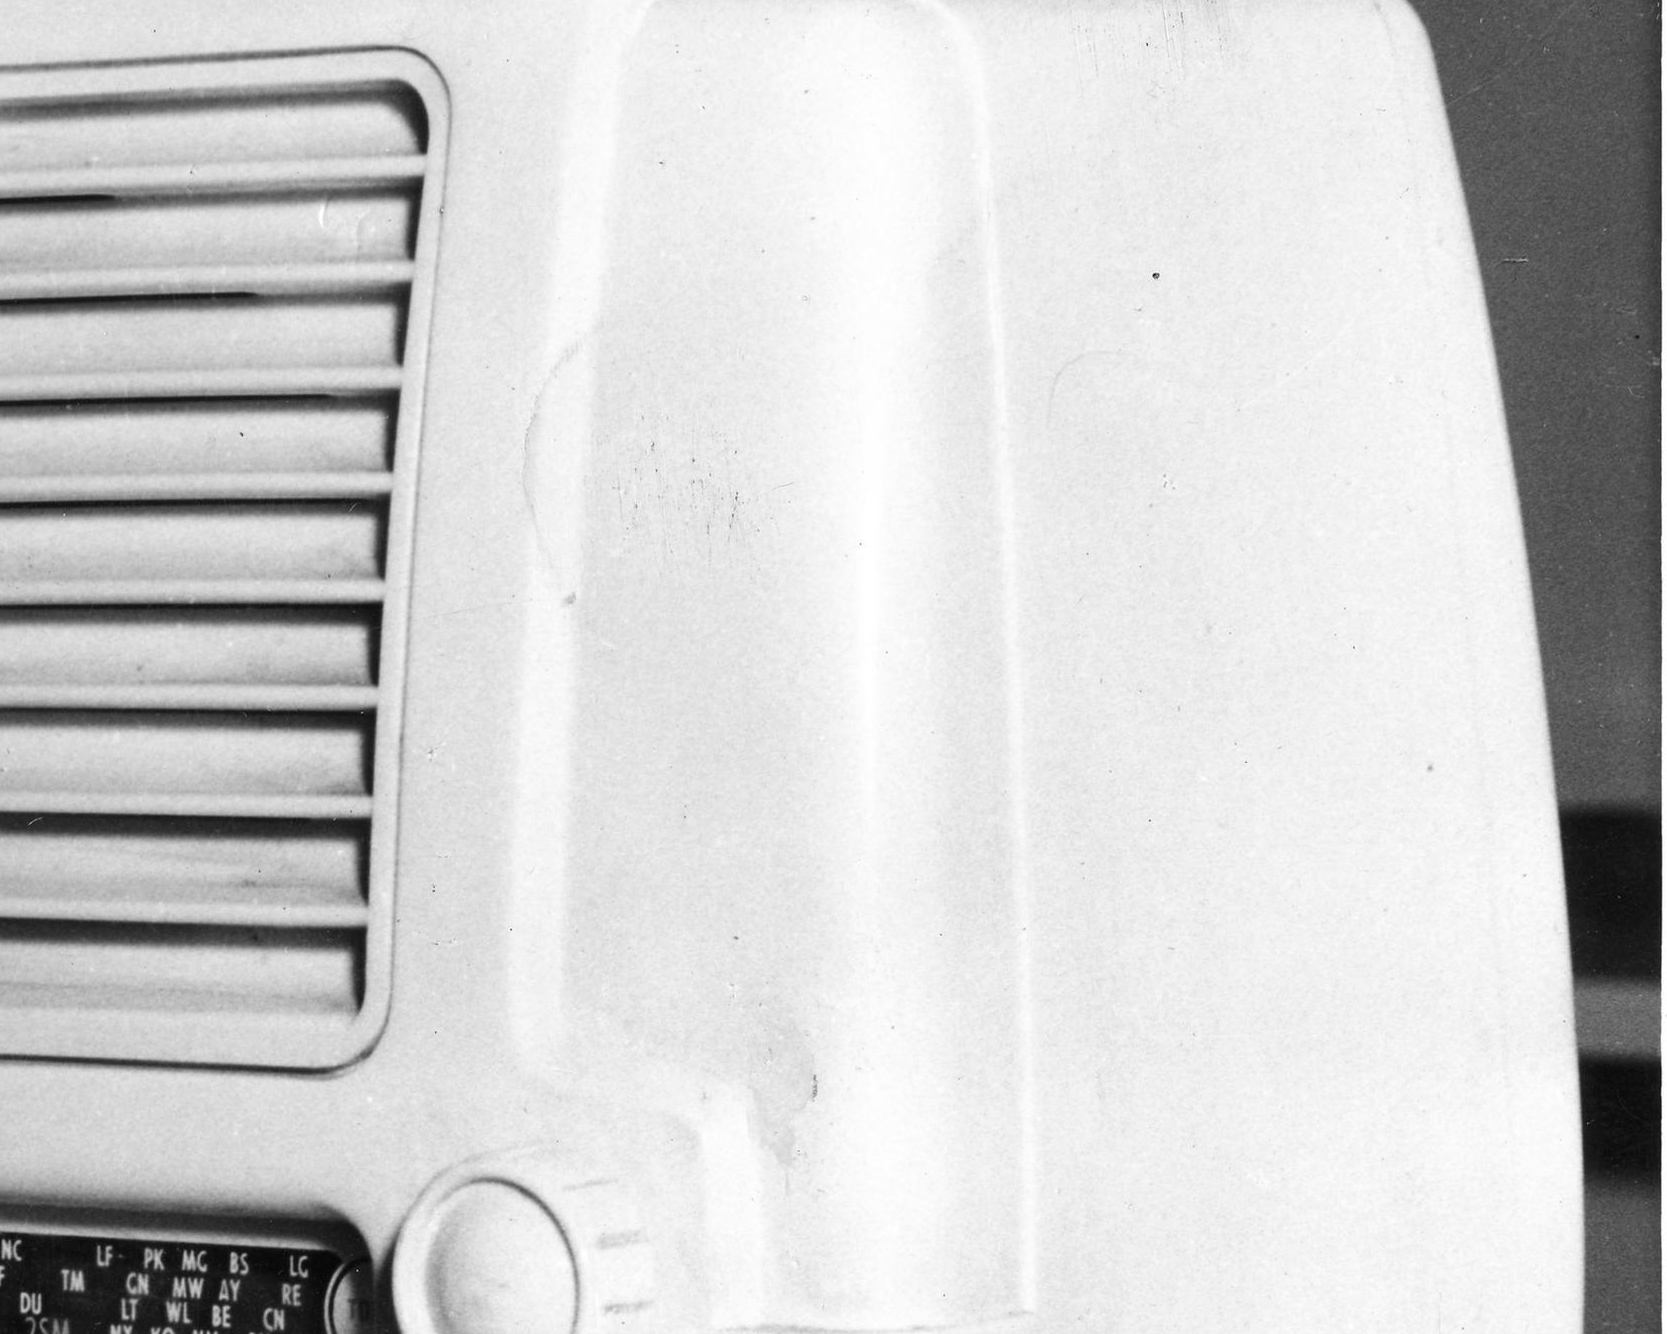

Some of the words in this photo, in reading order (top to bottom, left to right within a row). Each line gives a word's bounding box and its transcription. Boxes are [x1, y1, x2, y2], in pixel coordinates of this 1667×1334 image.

[1, 1239, 22, 1261] NC
[96, 1245, 113, 1267] LF
[144, 1248, 165, 1271] PK
[182, 1250, 207, 1272] MG
[230, 1251, 249, 1275] BS
[61, 1269, 85, 1292] TM
[172, 1277, 204, 1300] MW
[219, 1279, 241, 1301] AY
[20, 1292, 42, 1314] DU
[282, 1283, 302, 1307] RE
[122, 1298, 138, 1321] LT
[165, 1301, 192, 1324] WL
[212, 1305, 231, 1328] BE
[263, 1307, 285, 1331] CN
